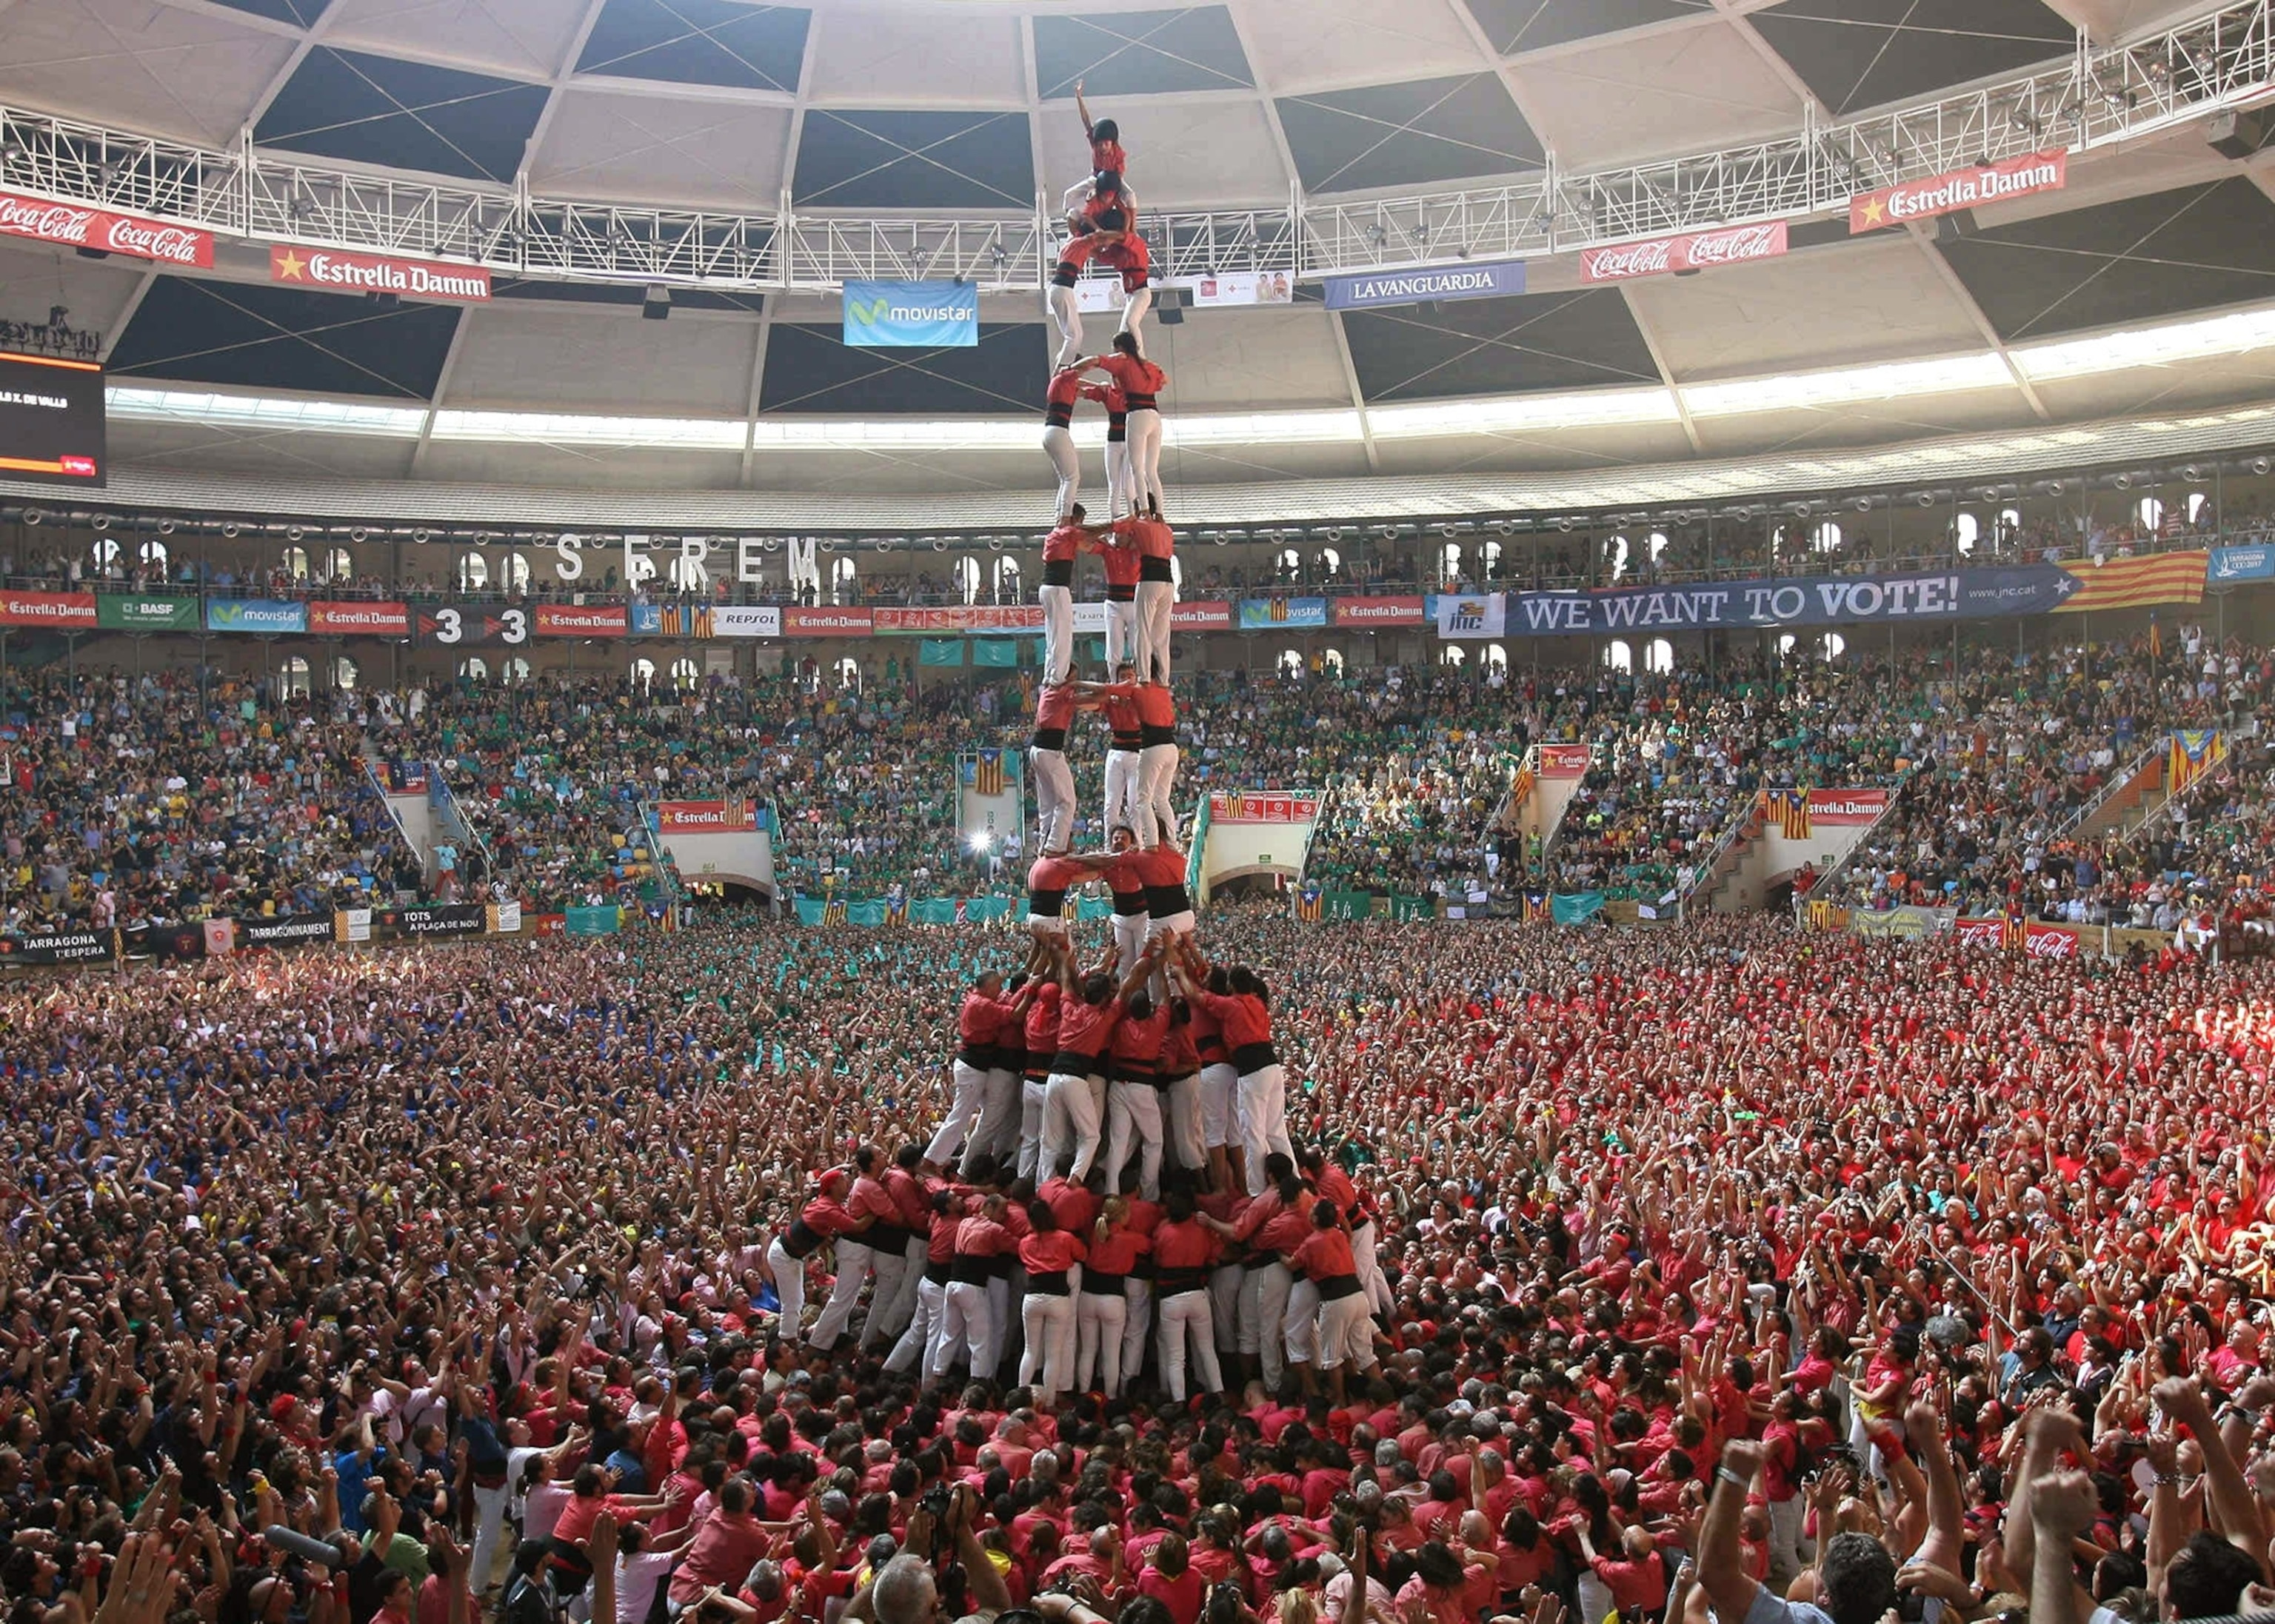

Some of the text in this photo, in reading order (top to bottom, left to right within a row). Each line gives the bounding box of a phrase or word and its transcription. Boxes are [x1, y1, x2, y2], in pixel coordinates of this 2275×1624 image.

[1888, 164, 2057, 217] Estrella Damm
[108, 219, 200, 262] Coca-Cola
[1688, 225, 1776, 264] Coca-Cola
[1592, 240, 1672, 278] Coca-Cola
[310, 253, 487, 297] Estrella Damm
[1354, 272, 1494, 298] LA VANGUARDIA
[891, 304, 974, 321] movistar
[1968, 584, 2036, 599] www.jnc.cat
[10, 601, 96, 616] Estrella Damm
[140, 604, 173, 614] BASF
[1523, 577, 1959, 629] WE WANT TO VOTE!
[244, 611, 300, 621] movistar
[326, 611, 407, 624] Estrella Damm
[1197, 611, 1229, 621] Damm
[1286, 607, 1322, 617] ovistar
[1350, 606, 1423, 617] Estrella Damm
[435, 609, 462, 644] 3
[501, 609, 527, 644] 3
[551, 615, 626, 626] Estrella Damm
[726, 615, 775, 624] REPSOL
[799, 616, 872, 627] Estrella Damm
[1808, 801, 1883, 815] strella Damm
[674, 812, 718, 823] Estrella
[404, 912, 431, 922] TOTS
[417, 922, 446, 932] PLAÇA
[23, 935, 97, 949] TARRAGONA
[54, 946, 106, 958] T'ESPERA
